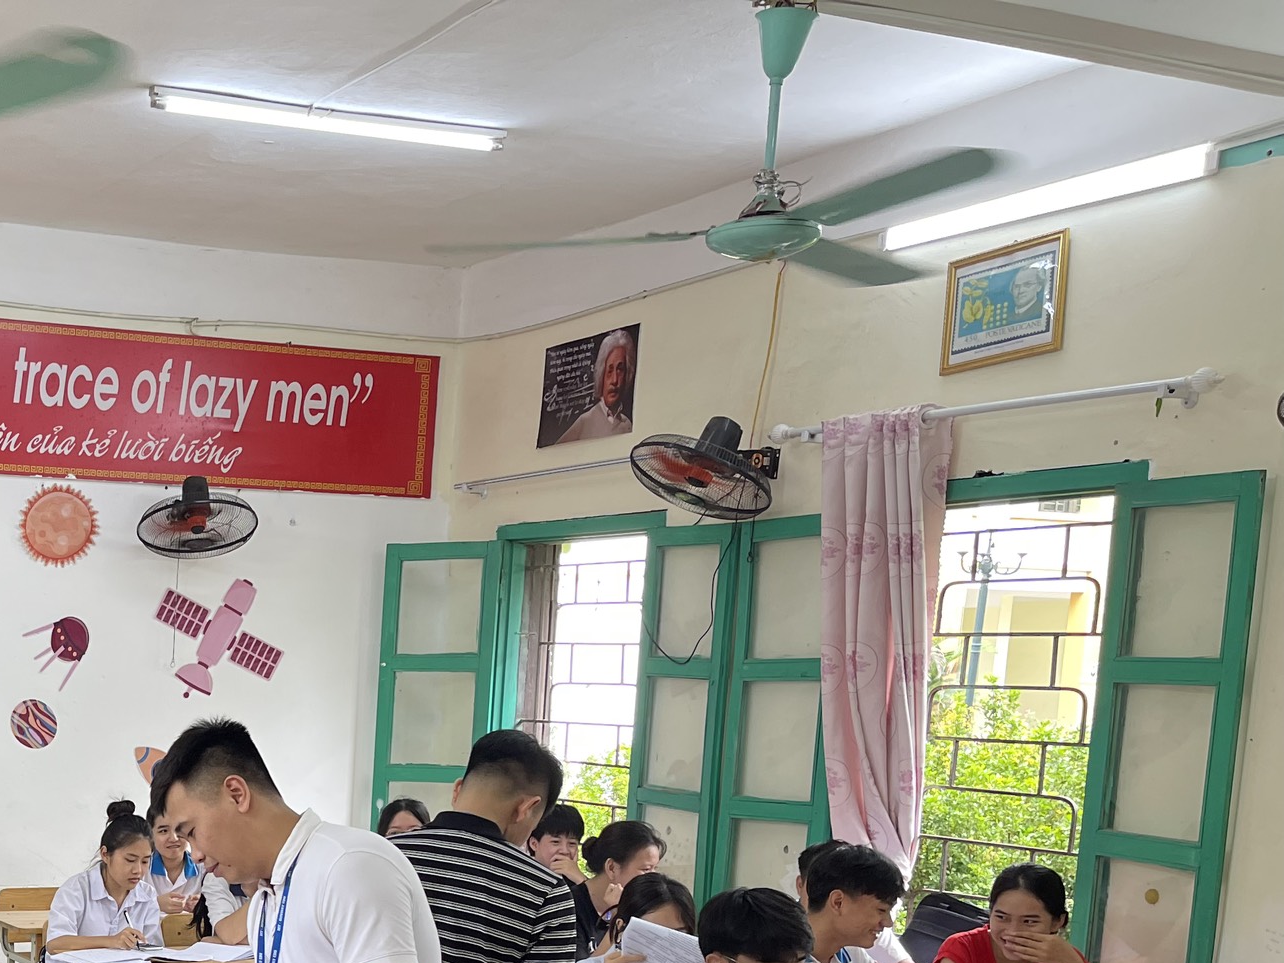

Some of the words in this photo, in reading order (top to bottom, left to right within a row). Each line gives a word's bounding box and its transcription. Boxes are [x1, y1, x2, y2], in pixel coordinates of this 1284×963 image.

[14, 347, 119, 411] trace
[132, 359, 173, 414] of
[179, 361, 259, 432] lazy
[266, 373, 374, 427] men”
[27, 426, 76, 457] của
[78, 429, 118, 460] kẻ
[114, 432, 165, 462] lười
[169, 431, 243, 474] biếng
